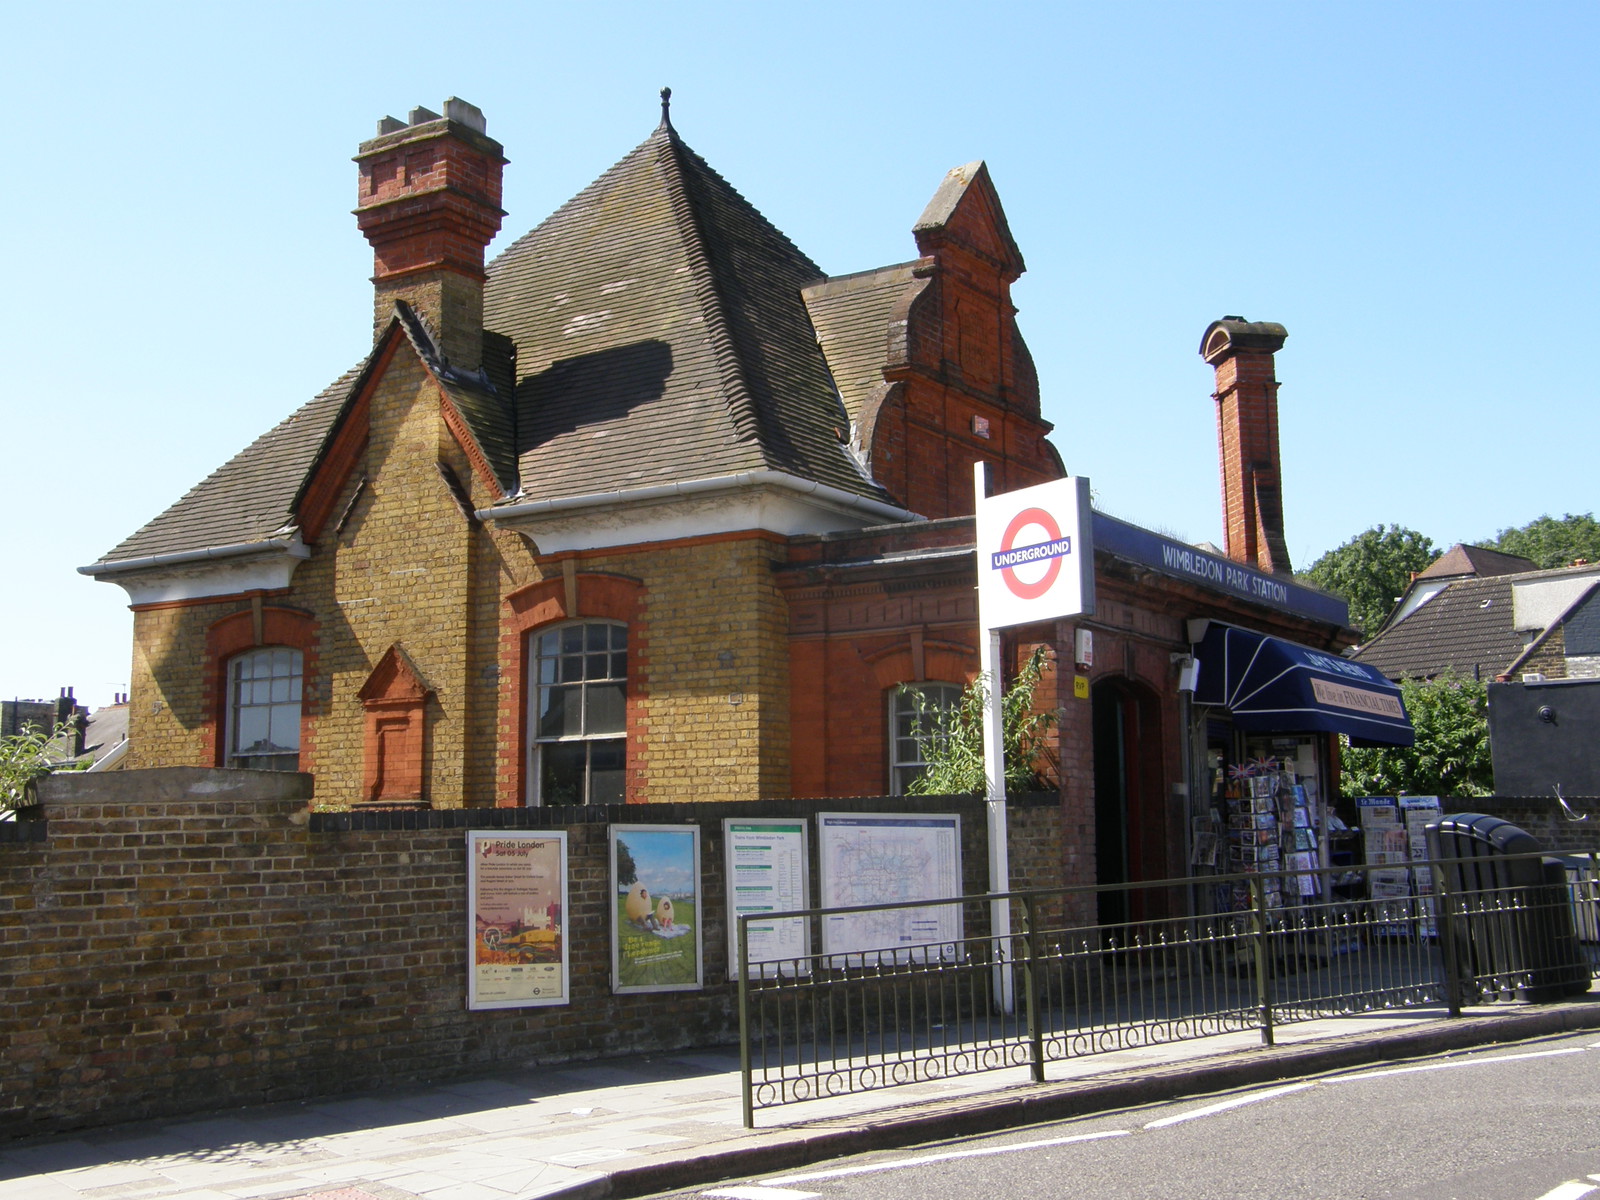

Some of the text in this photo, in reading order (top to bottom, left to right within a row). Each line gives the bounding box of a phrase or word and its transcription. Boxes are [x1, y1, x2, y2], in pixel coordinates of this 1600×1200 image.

[994, 541, 1069, 567] UNDERGROUND
[1162, 544, 1287, 603] WIMBLEDON PARK STATION
[1331, 659, 1372, 679] NEWS
[1343, 690, 1382, 711] FINANCIAL
[1380, 698, 1401, 715] TIMES
[496, 840, 545, 849] Pride London
[517, 850, 529, 858] July
